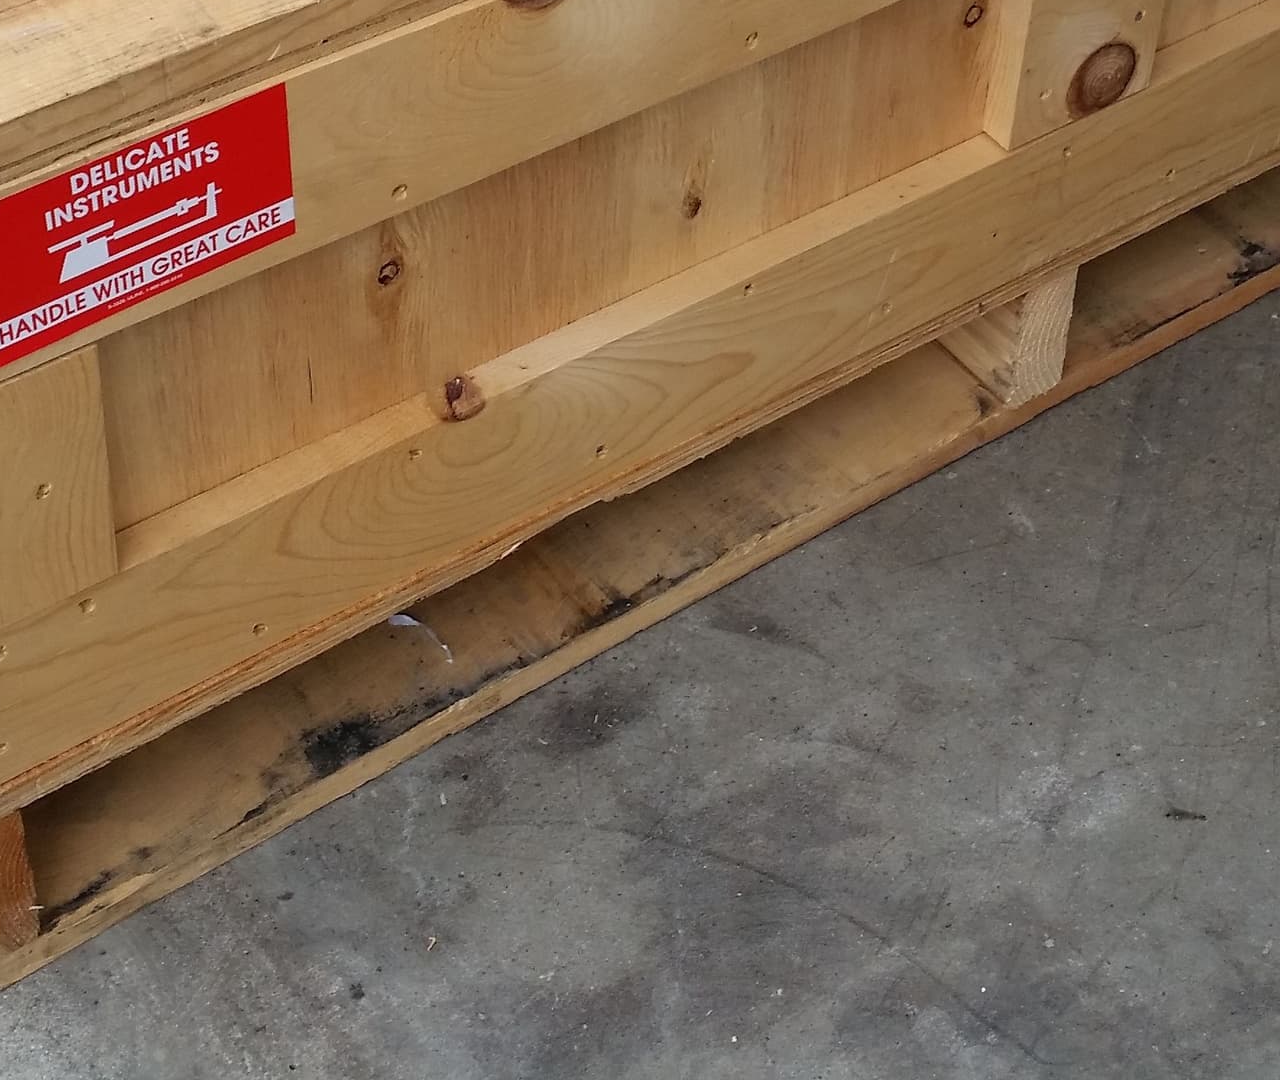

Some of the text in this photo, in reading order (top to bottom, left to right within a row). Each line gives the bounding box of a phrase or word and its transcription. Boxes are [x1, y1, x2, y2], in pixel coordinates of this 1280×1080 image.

[45, 142, 220, 231] INSTRUMENTS
[70, 128, 190, 195] DELICATE
[0, 294, 86, 345] HANDLE
[93, 267, 145, 301] WITH
[151, 234, 219, 275] GREAT
[226, 207, 281, 242] CARE
